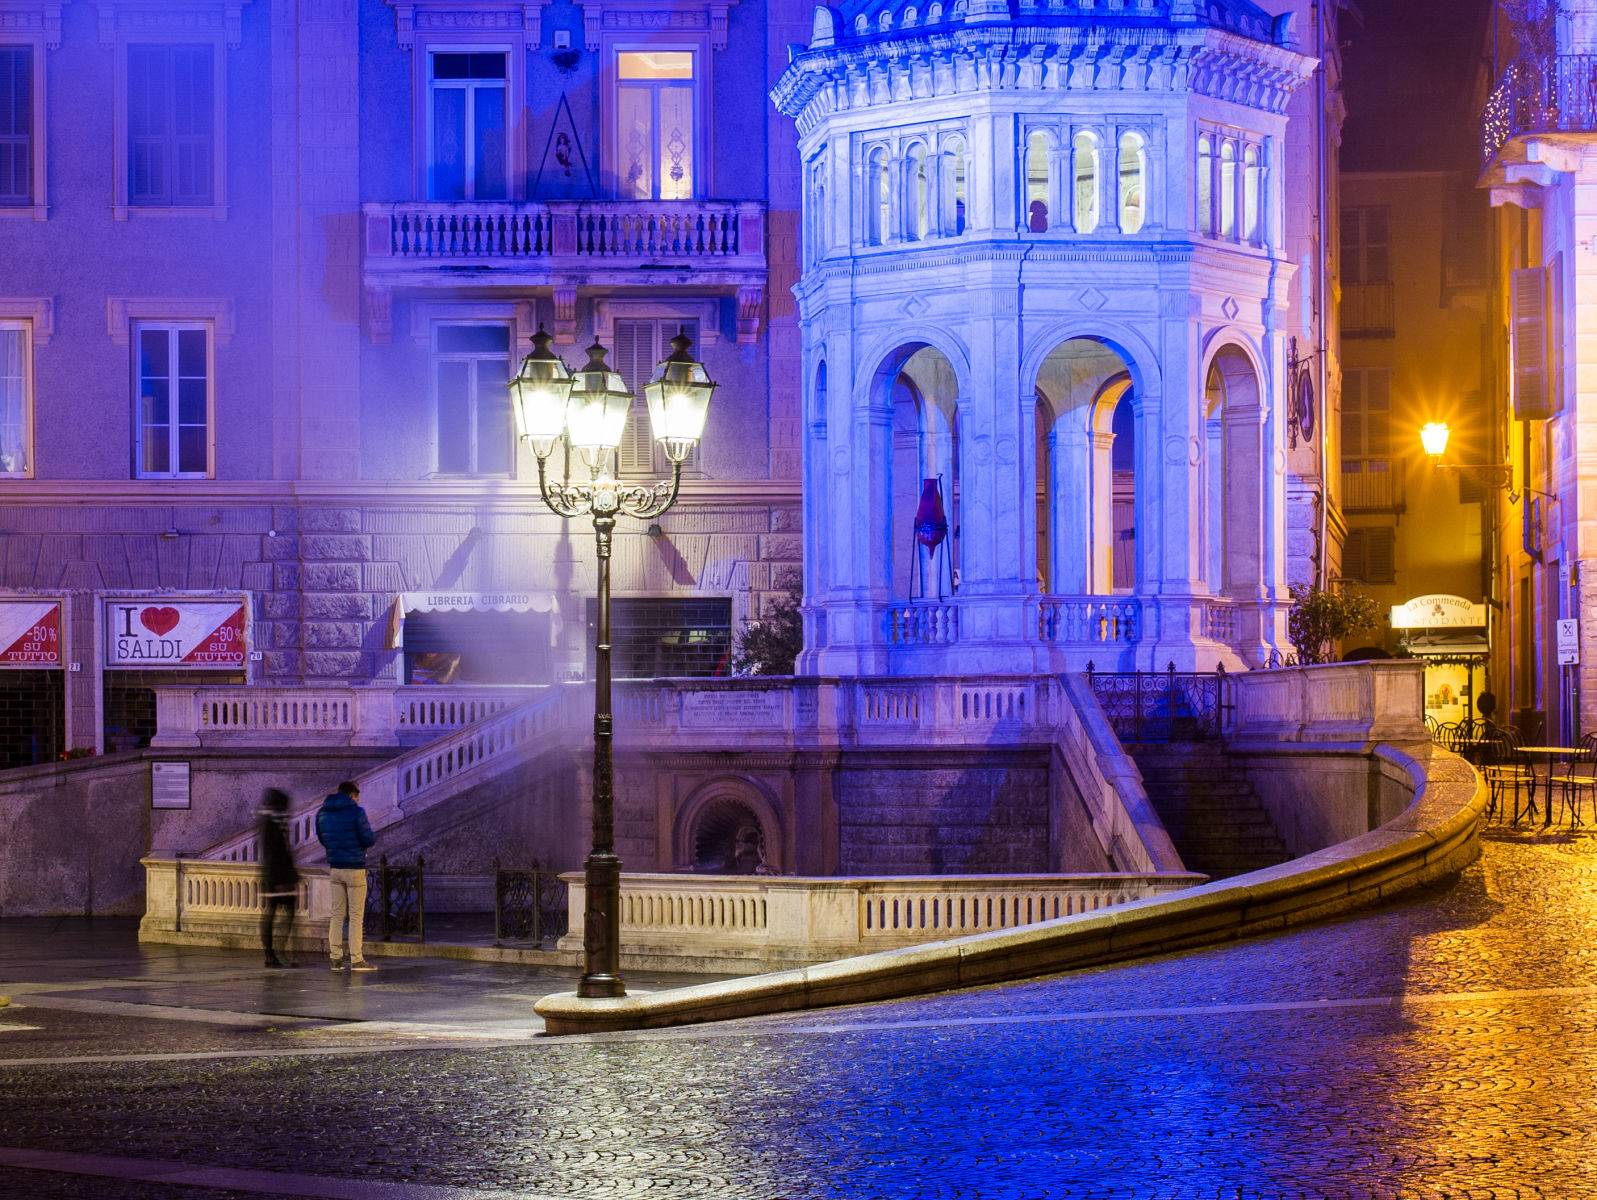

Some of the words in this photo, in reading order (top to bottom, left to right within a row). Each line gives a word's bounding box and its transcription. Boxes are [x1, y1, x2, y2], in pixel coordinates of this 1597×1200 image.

[427, 596, 474, 606] LIBRERIA
[481, 594, 529, 605] CIBRARIO
[1420, 597, 1471, 612] Commenda
[118, 606, 138, 637] I
[1396, 616, 1483, 626] STORANTE
[23, 642, 42, 651] SU
[117, 639, 183, 659] SALDI
[209, 642, 227, 651] SU
[8, 651, 57, 661] TUTTO
[194, 651, 244, 662] TUTTO
